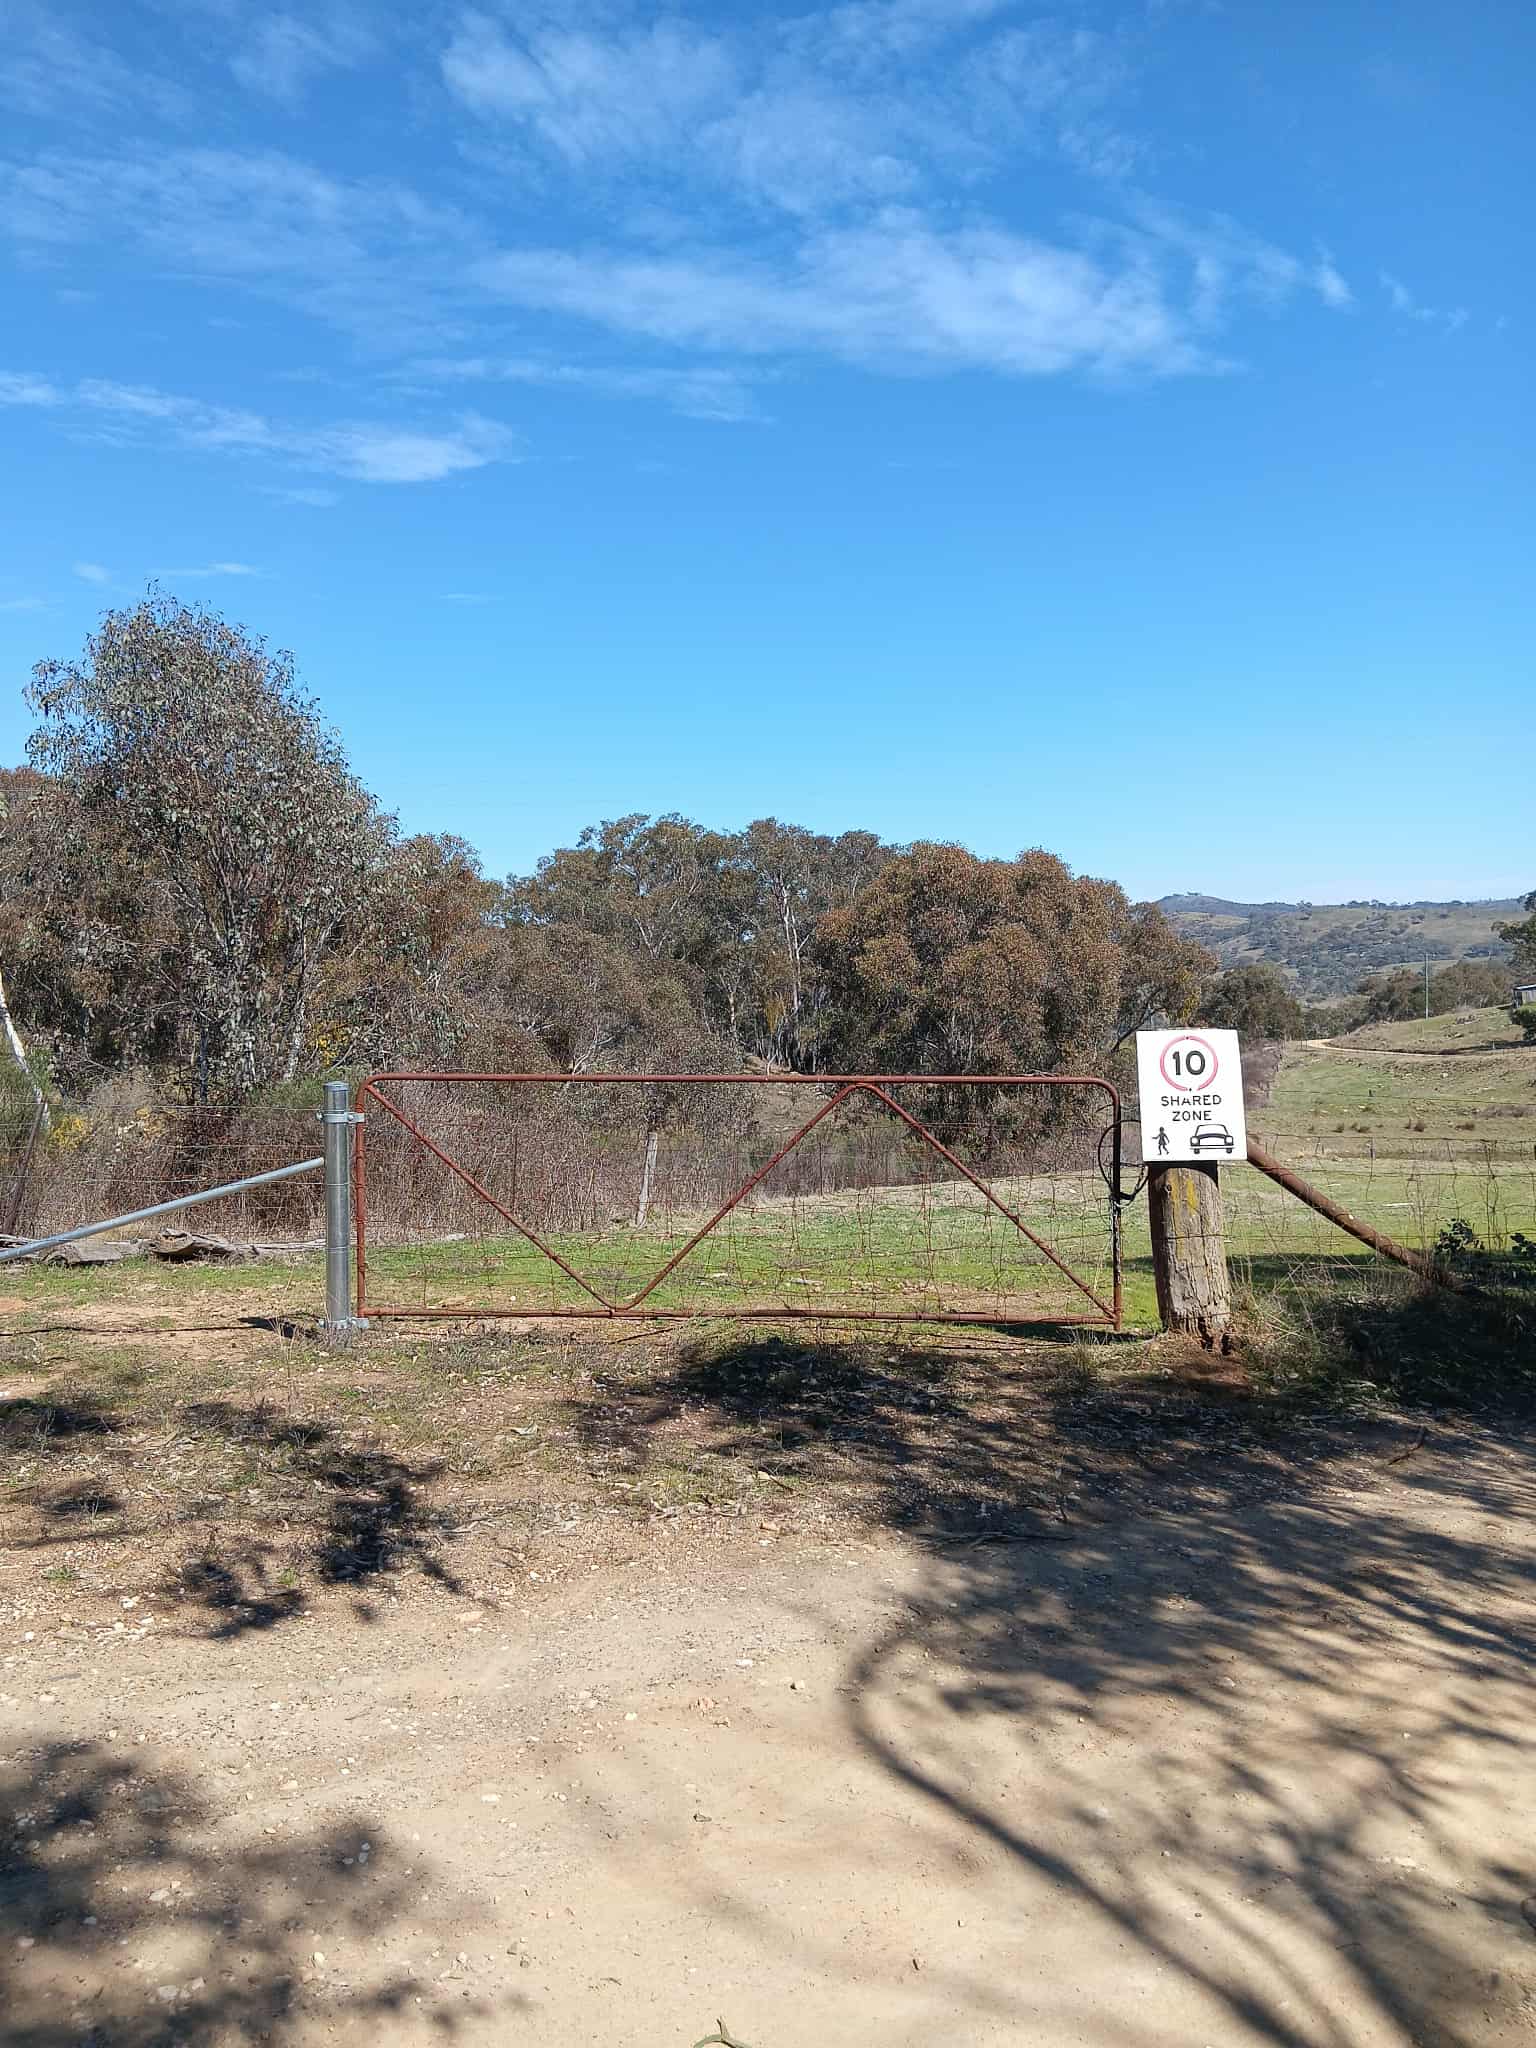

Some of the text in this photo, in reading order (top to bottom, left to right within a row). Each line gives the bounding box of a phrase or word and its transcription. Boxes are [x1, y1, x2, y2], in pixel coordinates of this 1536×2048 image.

[1172, 1050, 1206, 1076] 10
[1160, 1094, 1222, 1107] SHARED
[1172, 1110, 1212, 1122] ZONE
